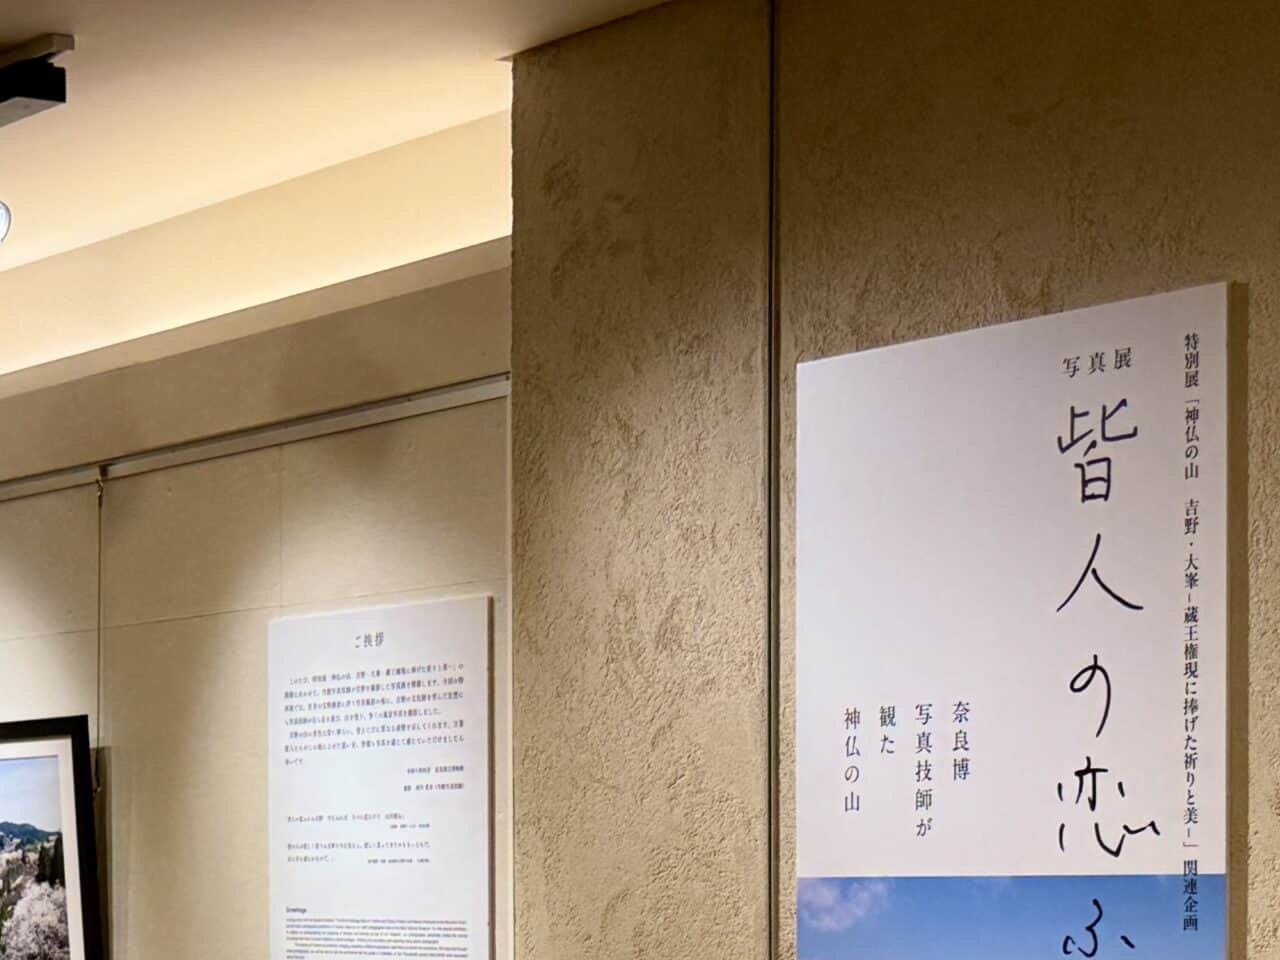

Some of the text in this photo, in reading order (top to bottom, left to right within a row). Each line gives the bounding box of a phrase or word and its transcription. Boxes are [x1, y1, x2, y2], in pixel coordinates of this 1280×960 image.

[1062, 347, 1132, 378] 写真展
[1184, 332, 1200, 480] 特別展「神仏の山
[354, 632, 384, 648] ご挨拶
[843, 708, 861, 813] 神仏の山
[879, 706, 896, 755] 観た
[952, 701, 970, 780] 奈良博
[914, 703, 934, 838] 写真技師が
